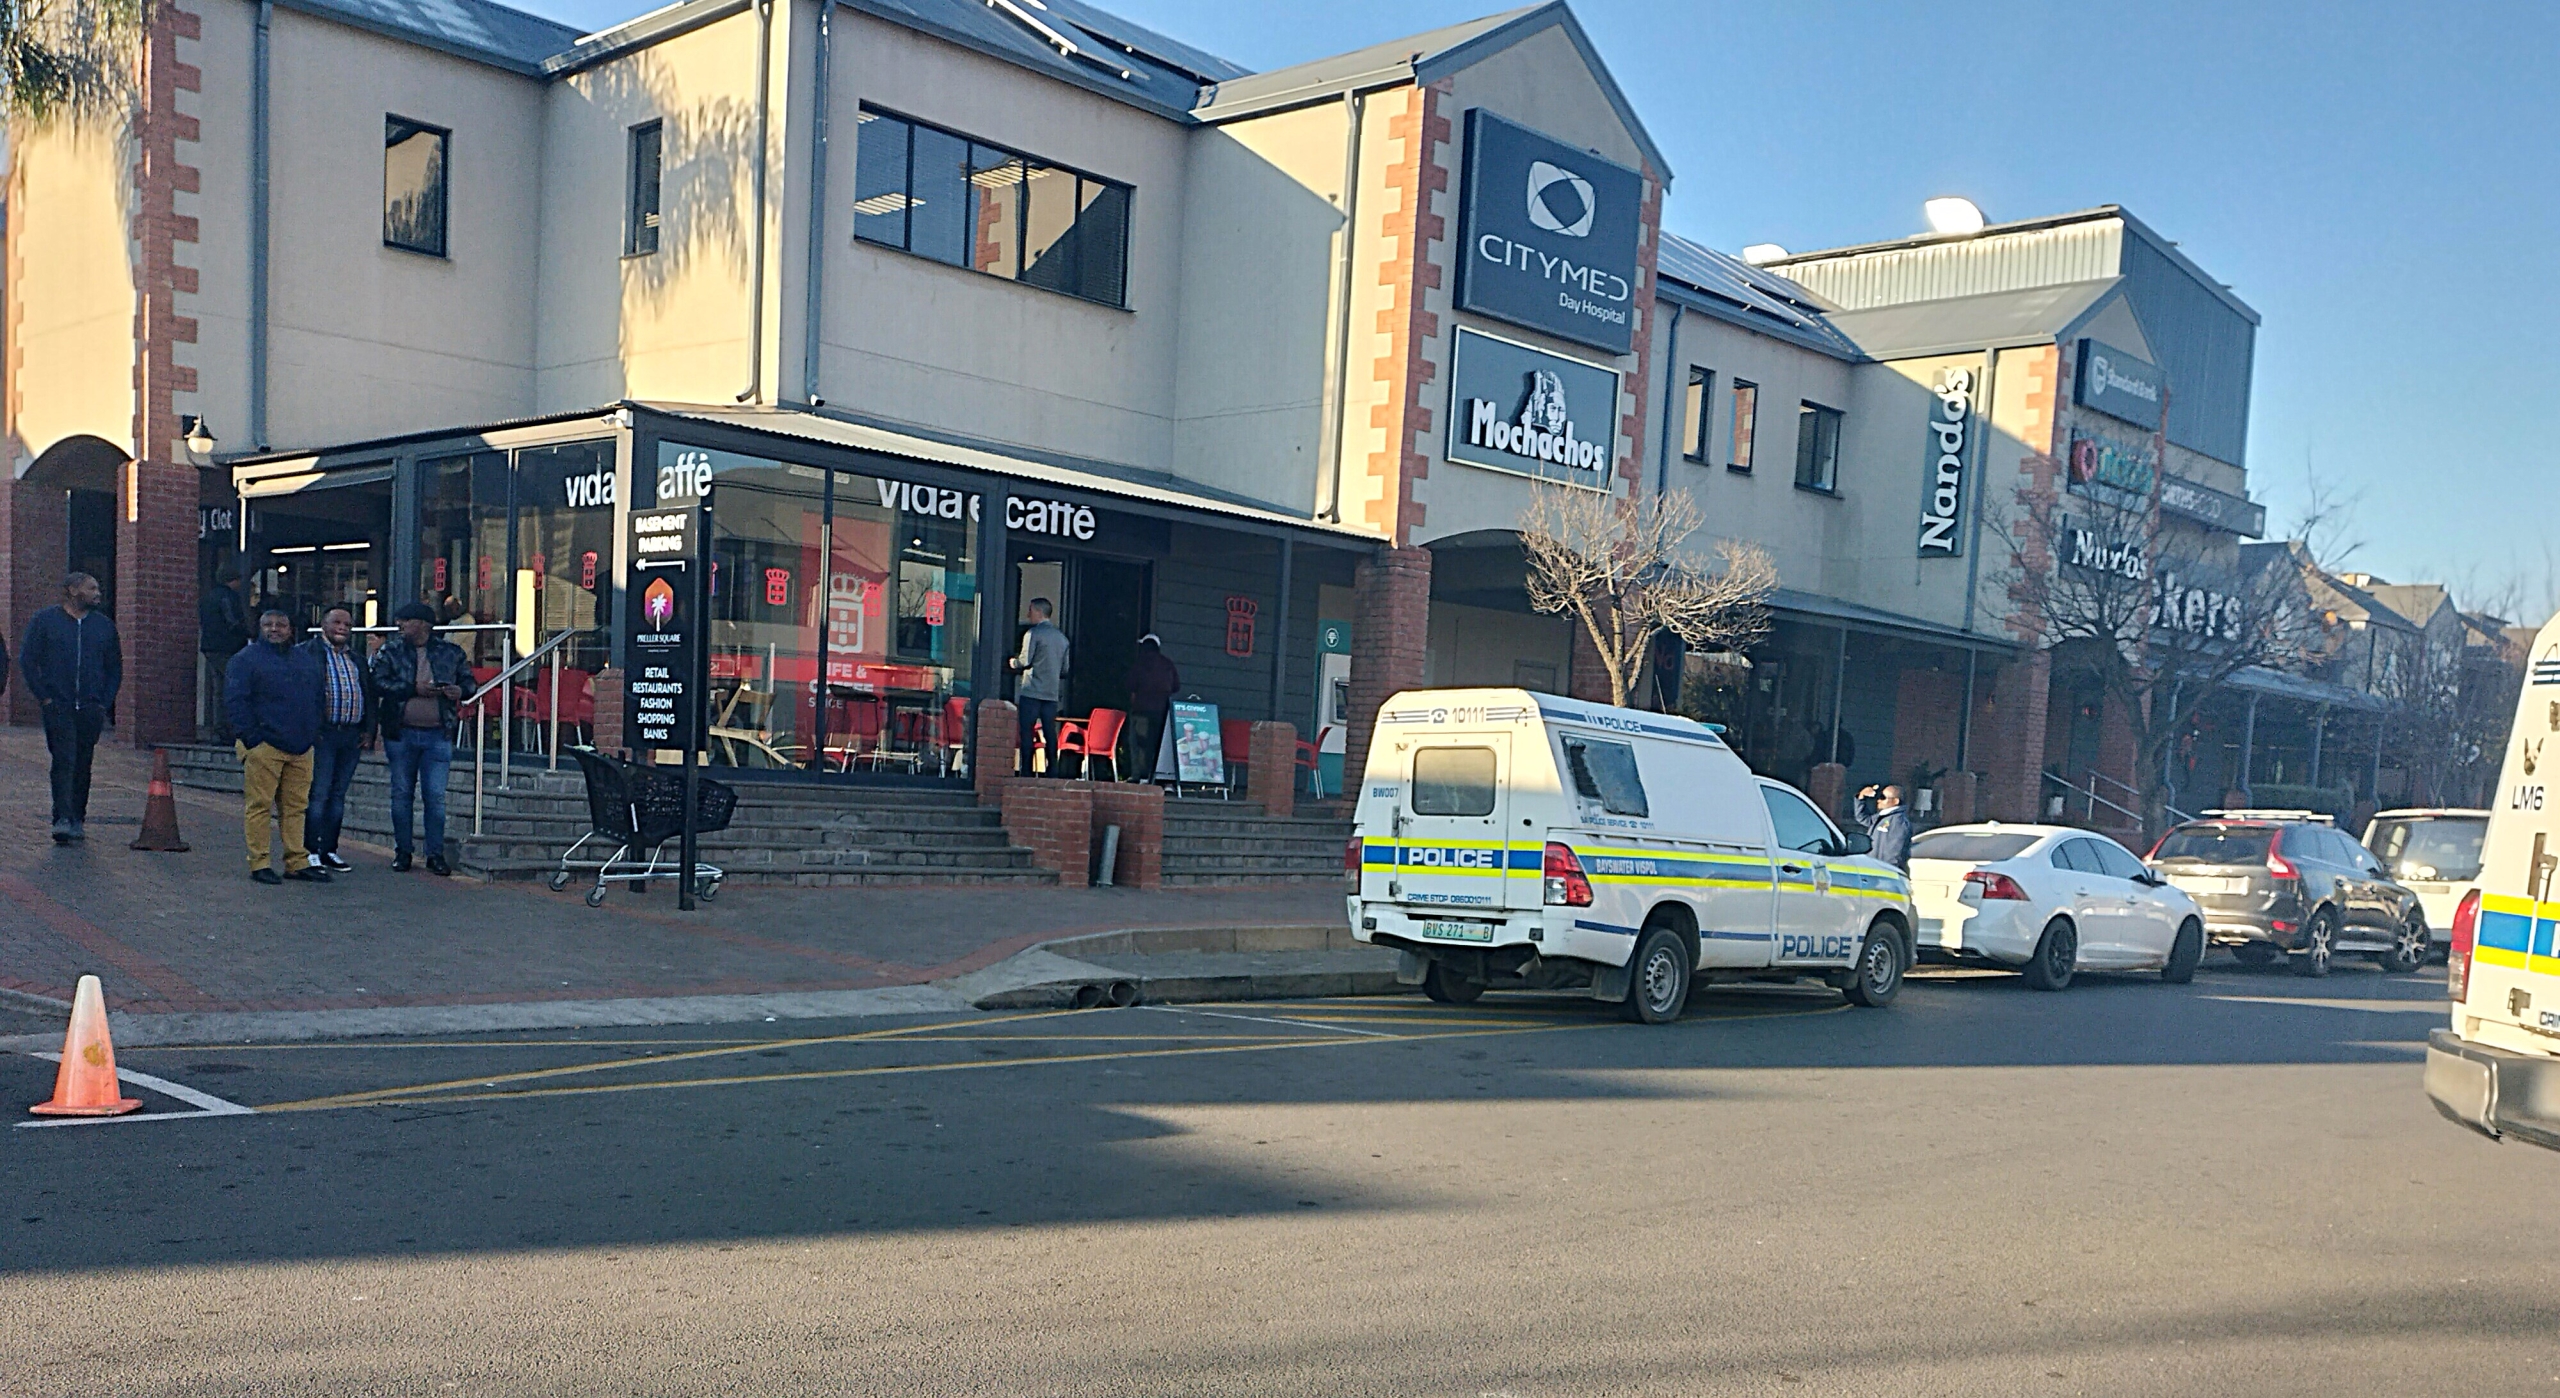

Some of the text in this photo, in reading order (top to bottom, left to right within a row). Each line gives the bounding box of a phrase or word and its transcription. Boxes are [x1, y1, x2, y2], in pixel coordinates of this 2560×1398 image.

[1478, 234, 1629, 302] CITYMED
[1559, 291, 1626, 325] Day Hospital
[1470, 397, 1605, 473] Mochachos
[1919, 365, 1974, 552] Nando's
[565, 456, 617, 508] vida
[634, 513, 688, 534] BASEMENT
[638, 534, 683, 554] PARKING
[644, 666, 670, 679] RETAIL
[632, 682, 683, 694] RESTAURANTS
[640, 697, 673, 709] FASHION
[637, 712, 676, 725] SHOPPING
[1452, 706, 1486, 724] 10111
[1603, 715, 1641, 733] POLICE
[643, 727, 668, 740] BANKS
[2511, 784, 2545, 811] LM6
[1407, 847, 1494, 869] POLICE
[1595, 858, 1635, 874] BAYSWATER
[1407, 892, 1430, 902] CRIME
[1430, 893, 1449, 903] STOP
[1425, 921, 1490, 940] BVS 271 B
[1782, 933, 1853, 960] POLICE
